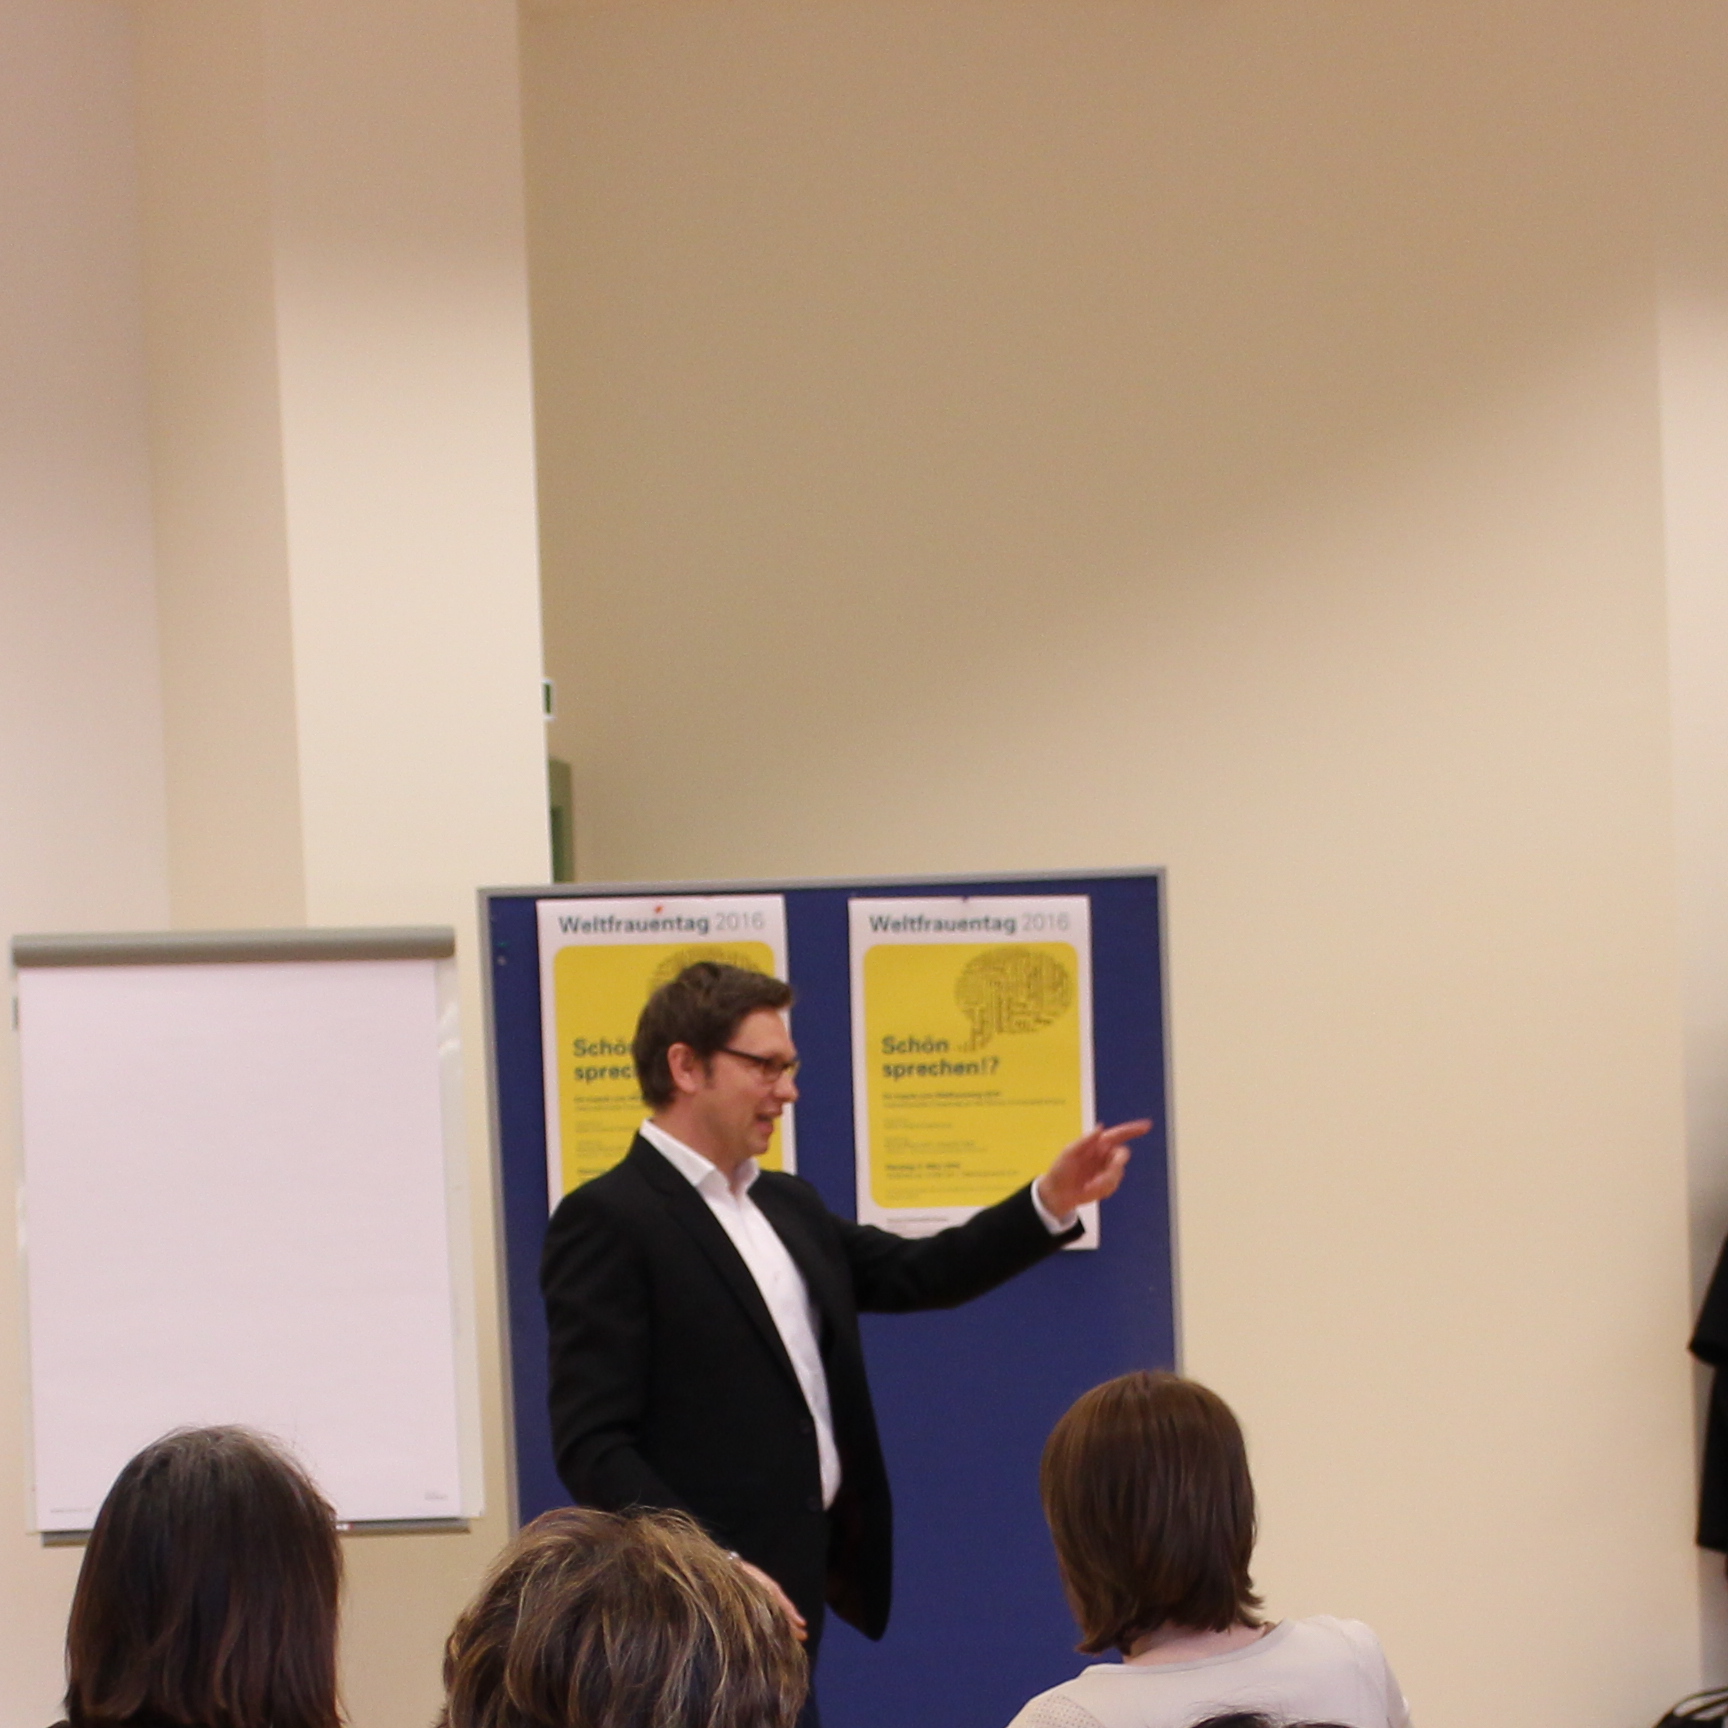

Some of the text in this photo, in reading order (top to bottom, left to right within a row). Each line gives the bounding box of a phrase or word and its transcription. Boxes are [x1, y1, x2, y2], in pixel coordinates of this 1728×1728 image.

[558, 911, 766, 935] Weltfrauentag 2016
[869, 911, 1070, 935] Weltfrauentag 2016
[881, 1035, 949, 1054] Schön
[574, 1065, 635, 1083] sprec
[882, 1056, 999, 1081] sprechen!?
